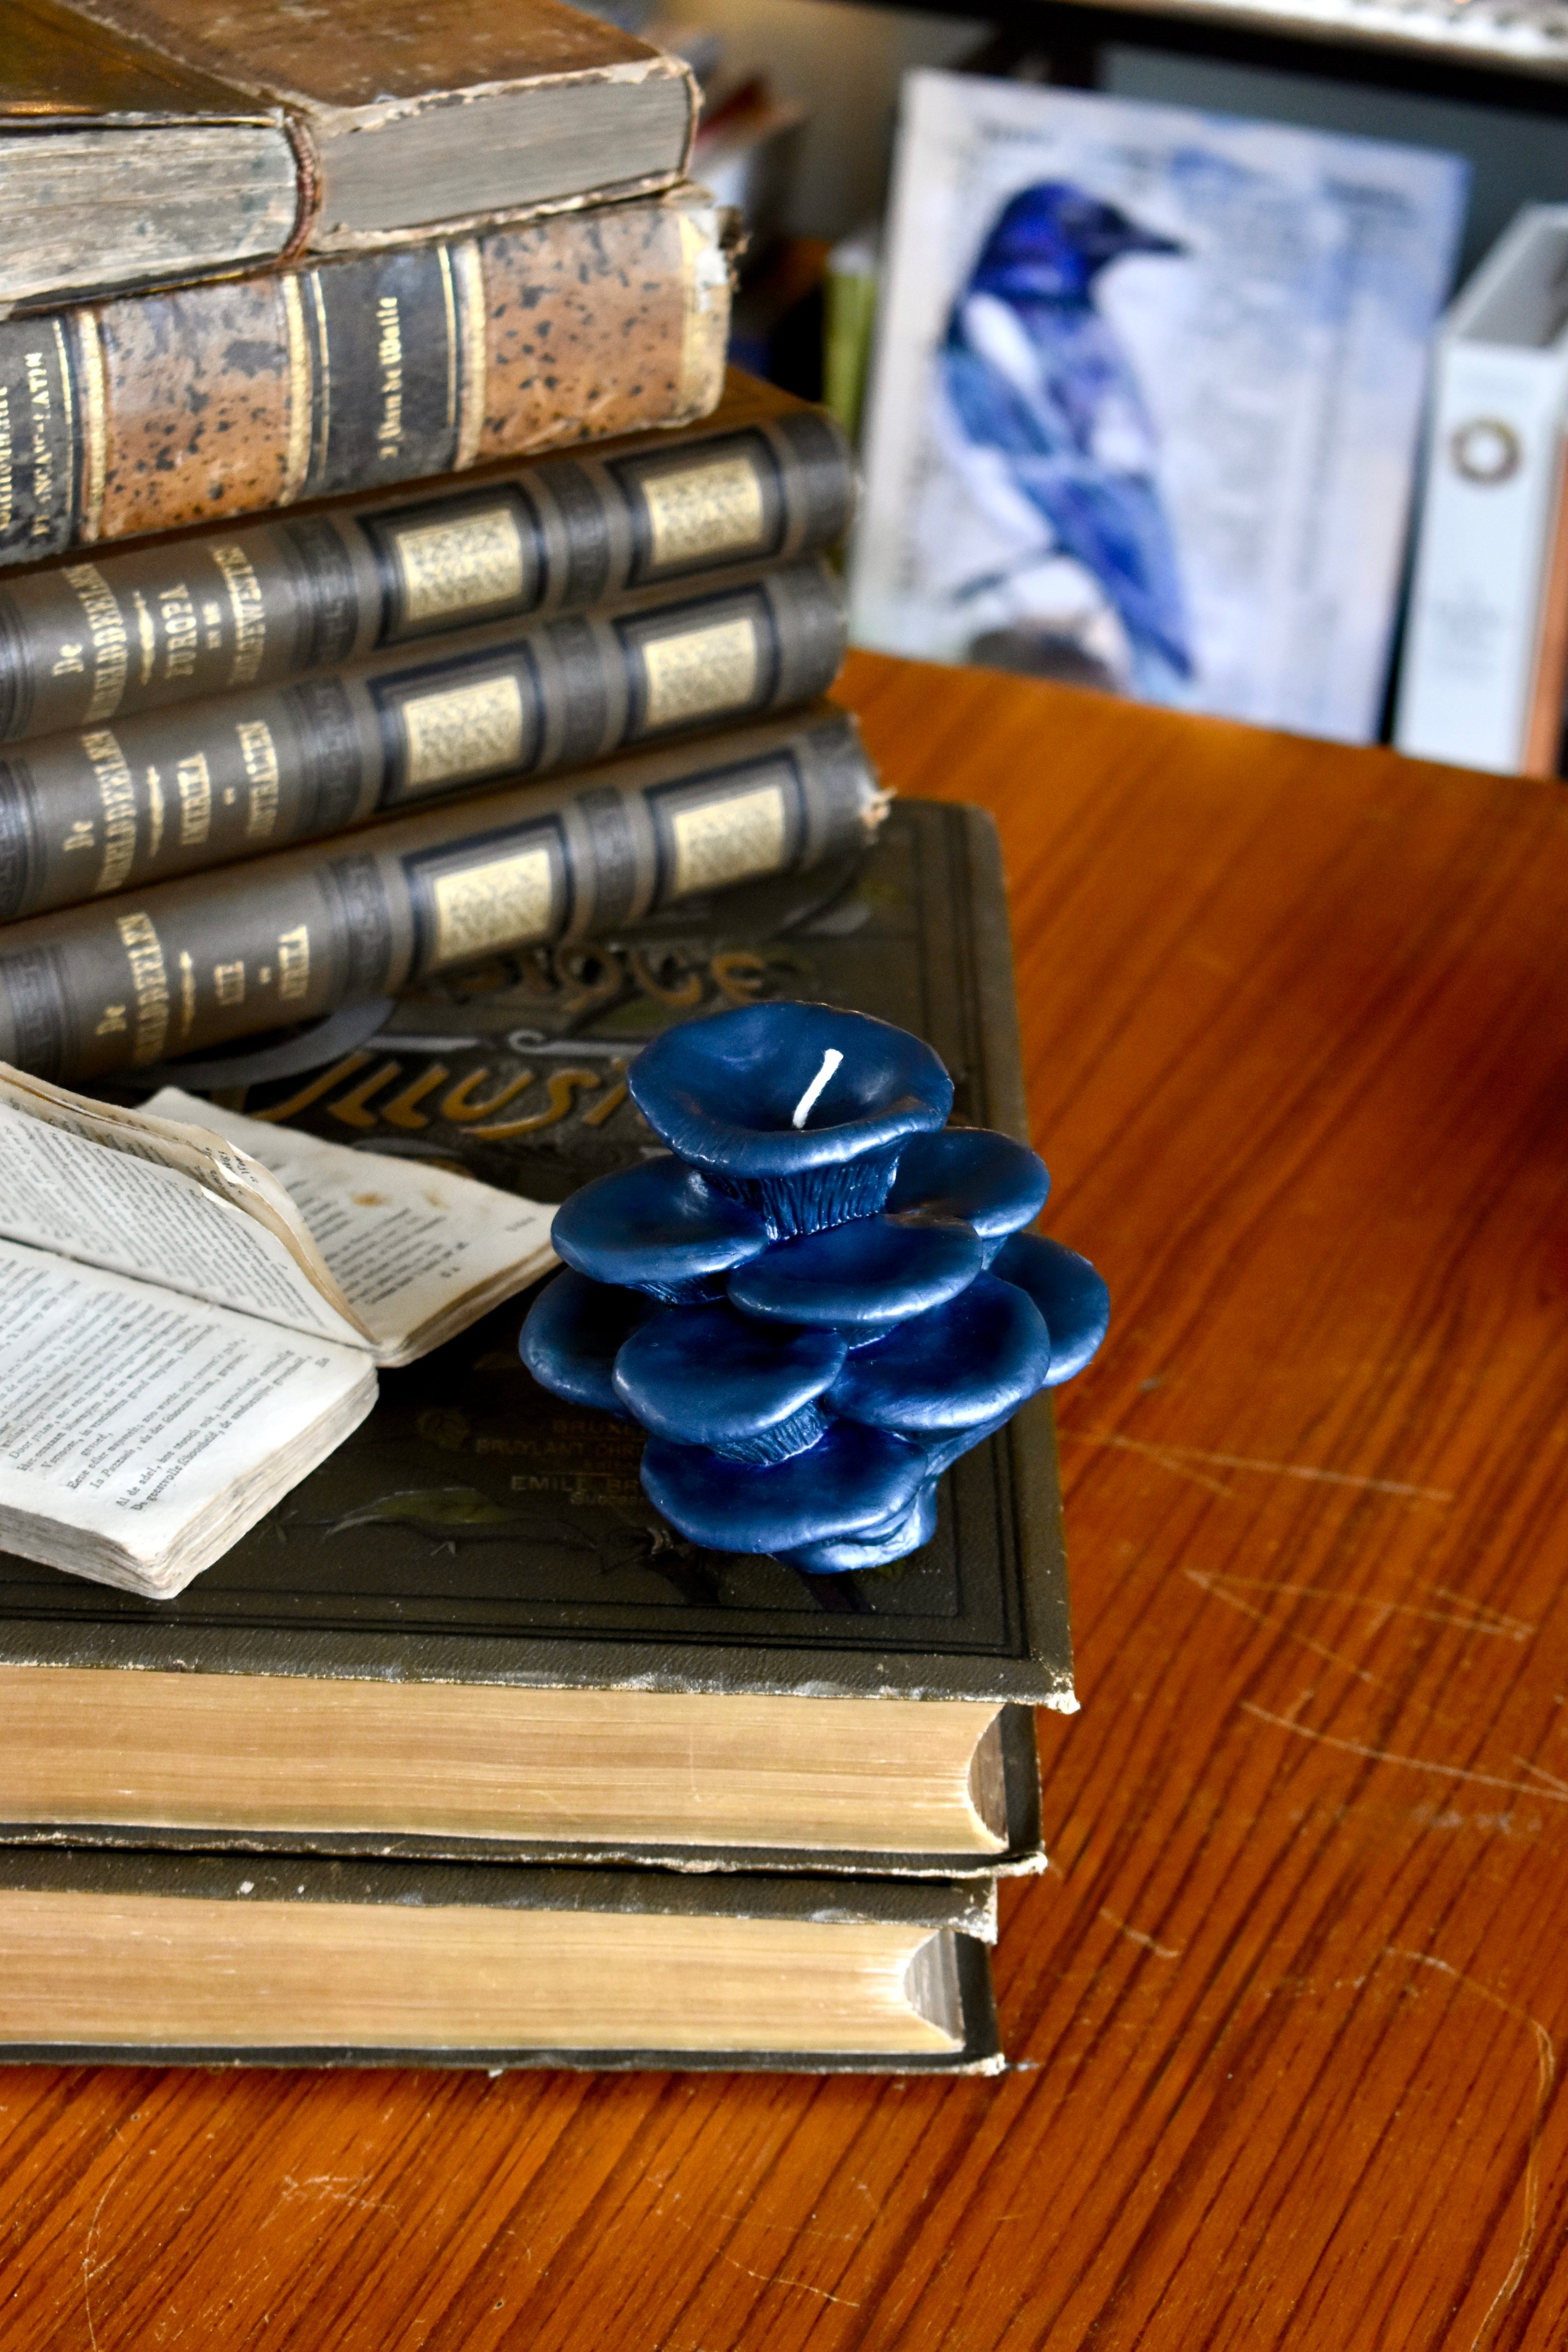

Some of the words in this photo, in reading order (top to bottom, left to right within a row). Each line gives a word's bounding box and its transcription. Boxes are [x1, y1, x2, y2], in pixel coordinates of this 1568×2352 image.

[8, 1441, 32, 1459] Door
[66, 1470, 89, 1489] Eene
[88, 1452, 108, 1468] edler
[142, 1411, 158, 1423] zoo
[80, 1433, 113, 1457] gevoed,
[89, 1479, 105, 1488] In
[140, 1434, 152, 1443] als
[149, 1423, 165, 1434] der
[115, 1497, 130, 1506] Al
[127, 1487, 140, 1496] de
[139, 1466, 162, 1485] adel,
[156, 1451, 174, 1463] hoe
[199, 1414, 221, 1428] ook,
[146, 1466, 182, 1502] geestvolle
[219, 1420, 232, 1428] de
